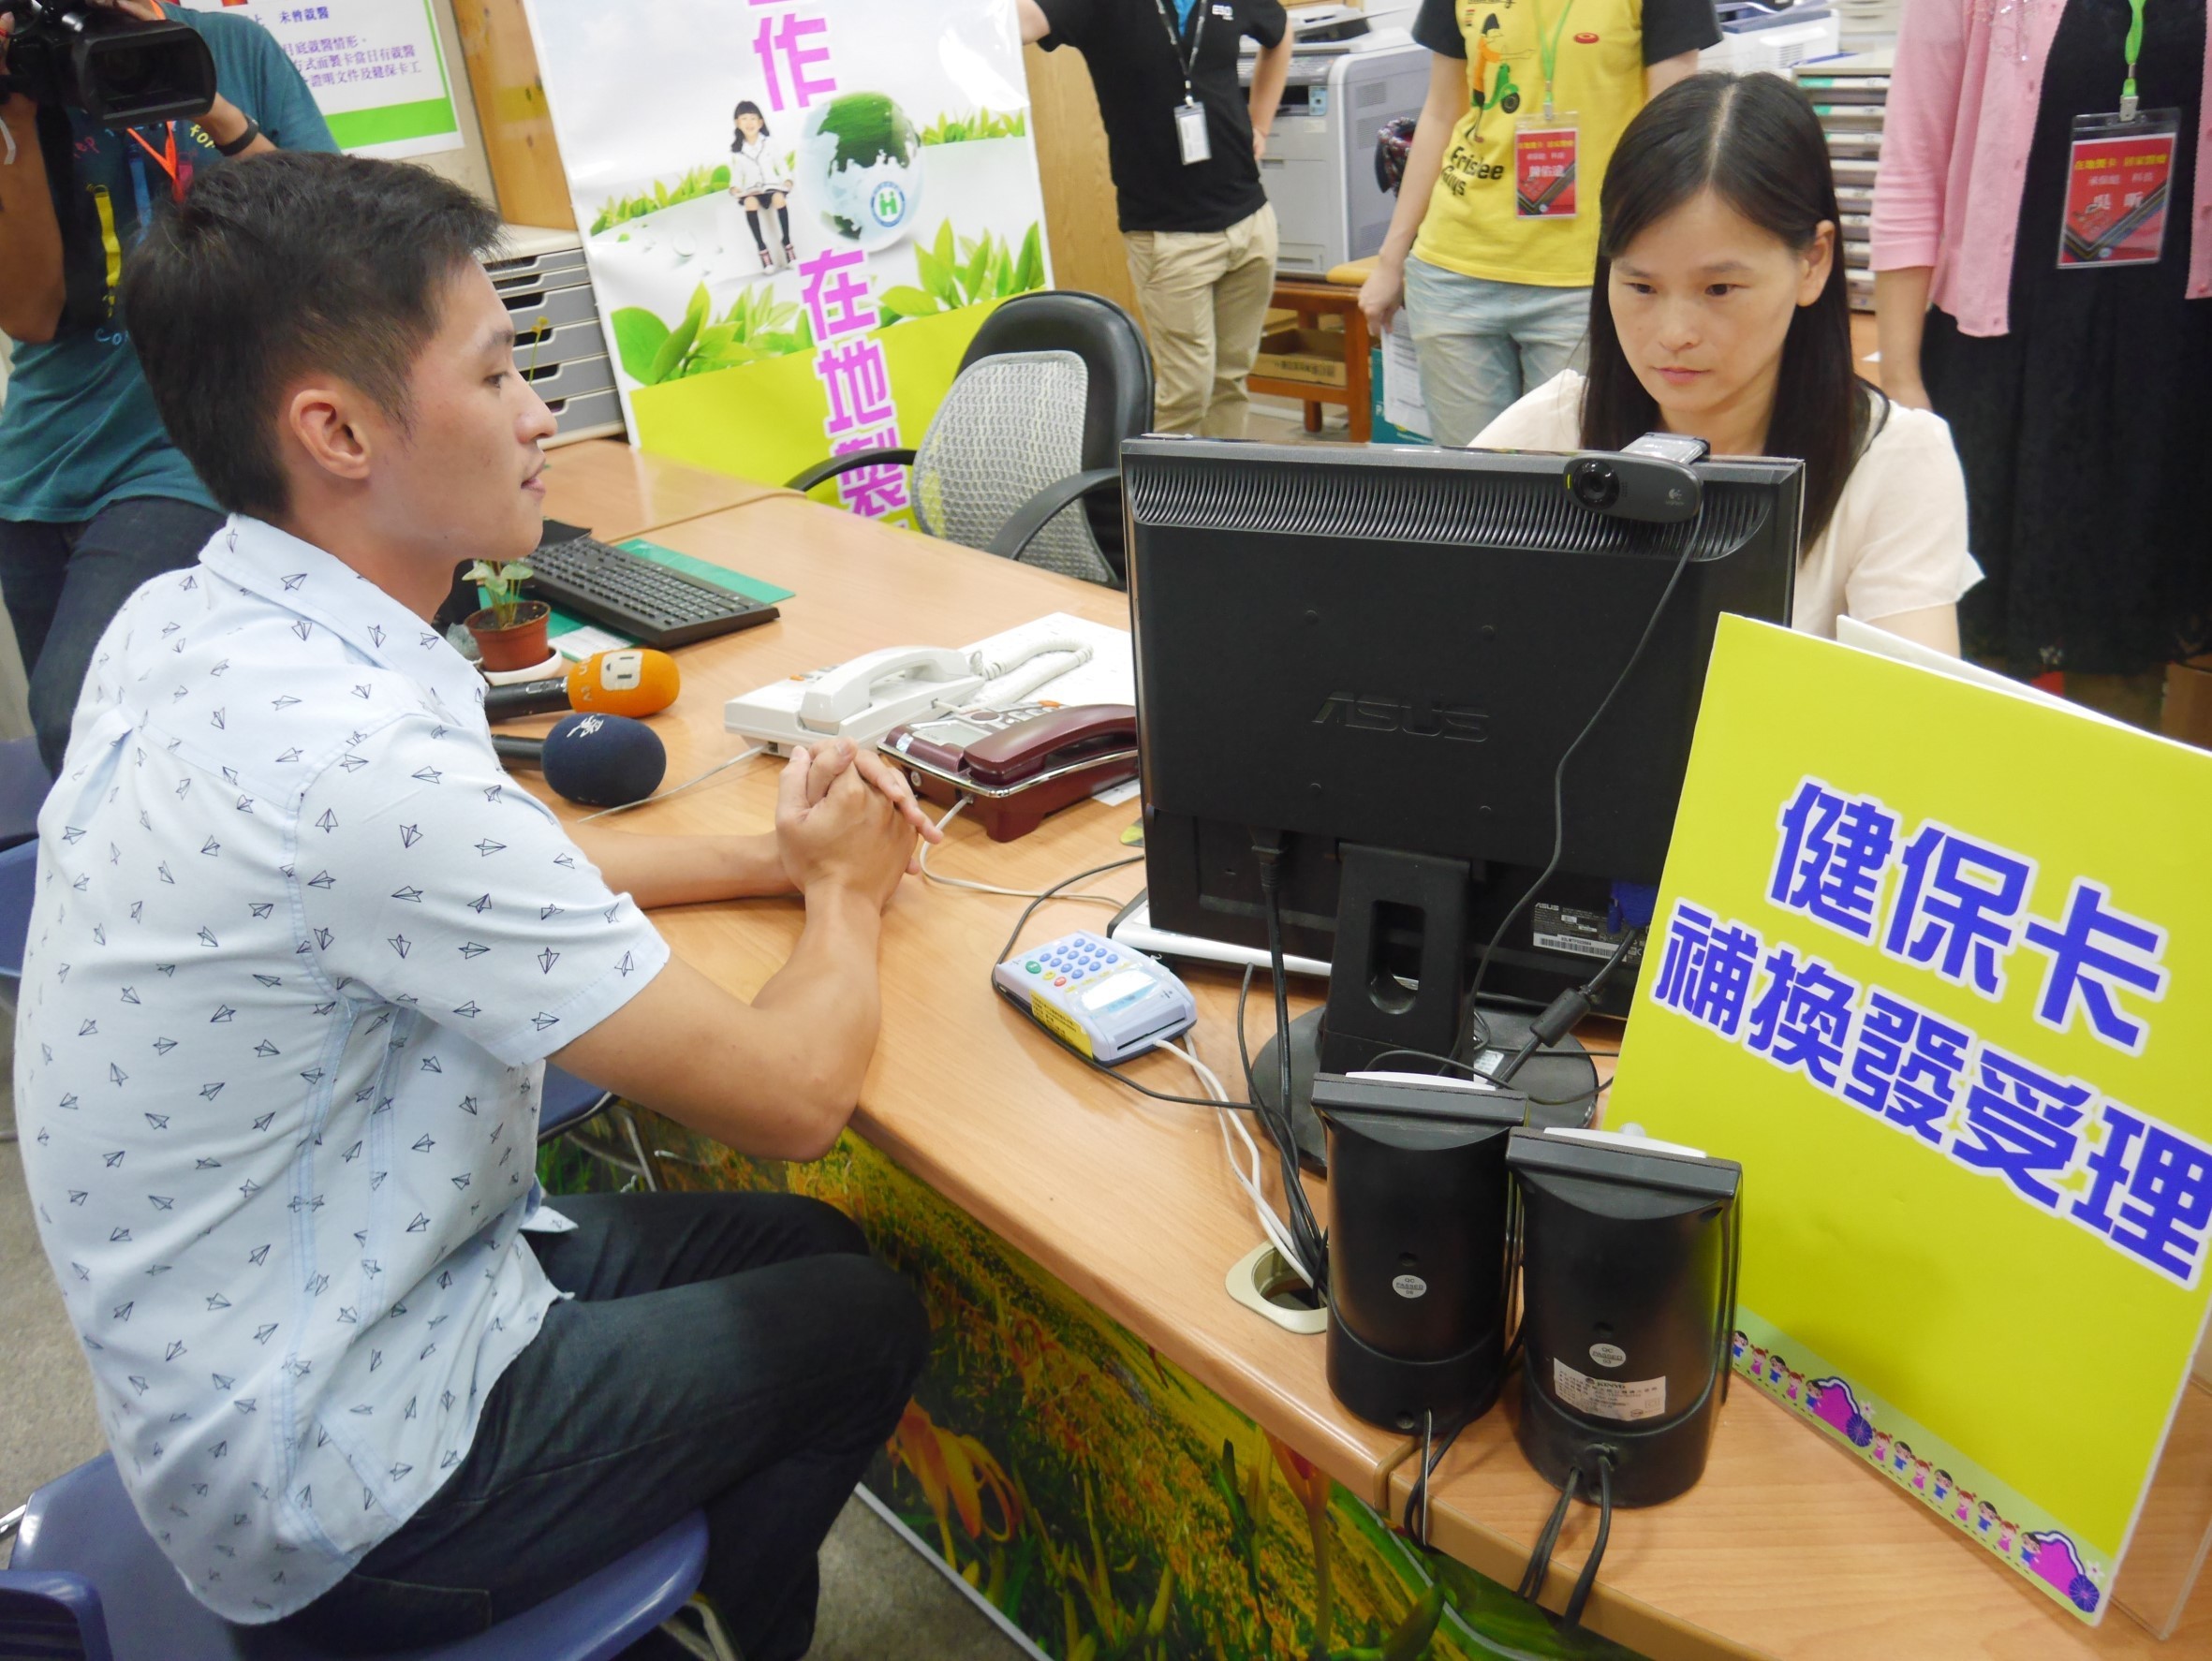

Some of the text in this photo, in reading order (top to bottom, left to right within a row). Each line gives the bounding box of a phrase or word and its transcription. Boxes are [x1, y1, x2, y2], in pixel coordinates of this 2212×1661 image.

[748, 0, 837, 111] 作
[798, 249, 908, 529] 在地製
[1311, 691, 1489, 742] ASUS
[1535, 902, 1559, 911] ASUS
[1770, 781, 2160, 1048] 健保卡
[1655, 904, 2212, 1281] 補換發受理
